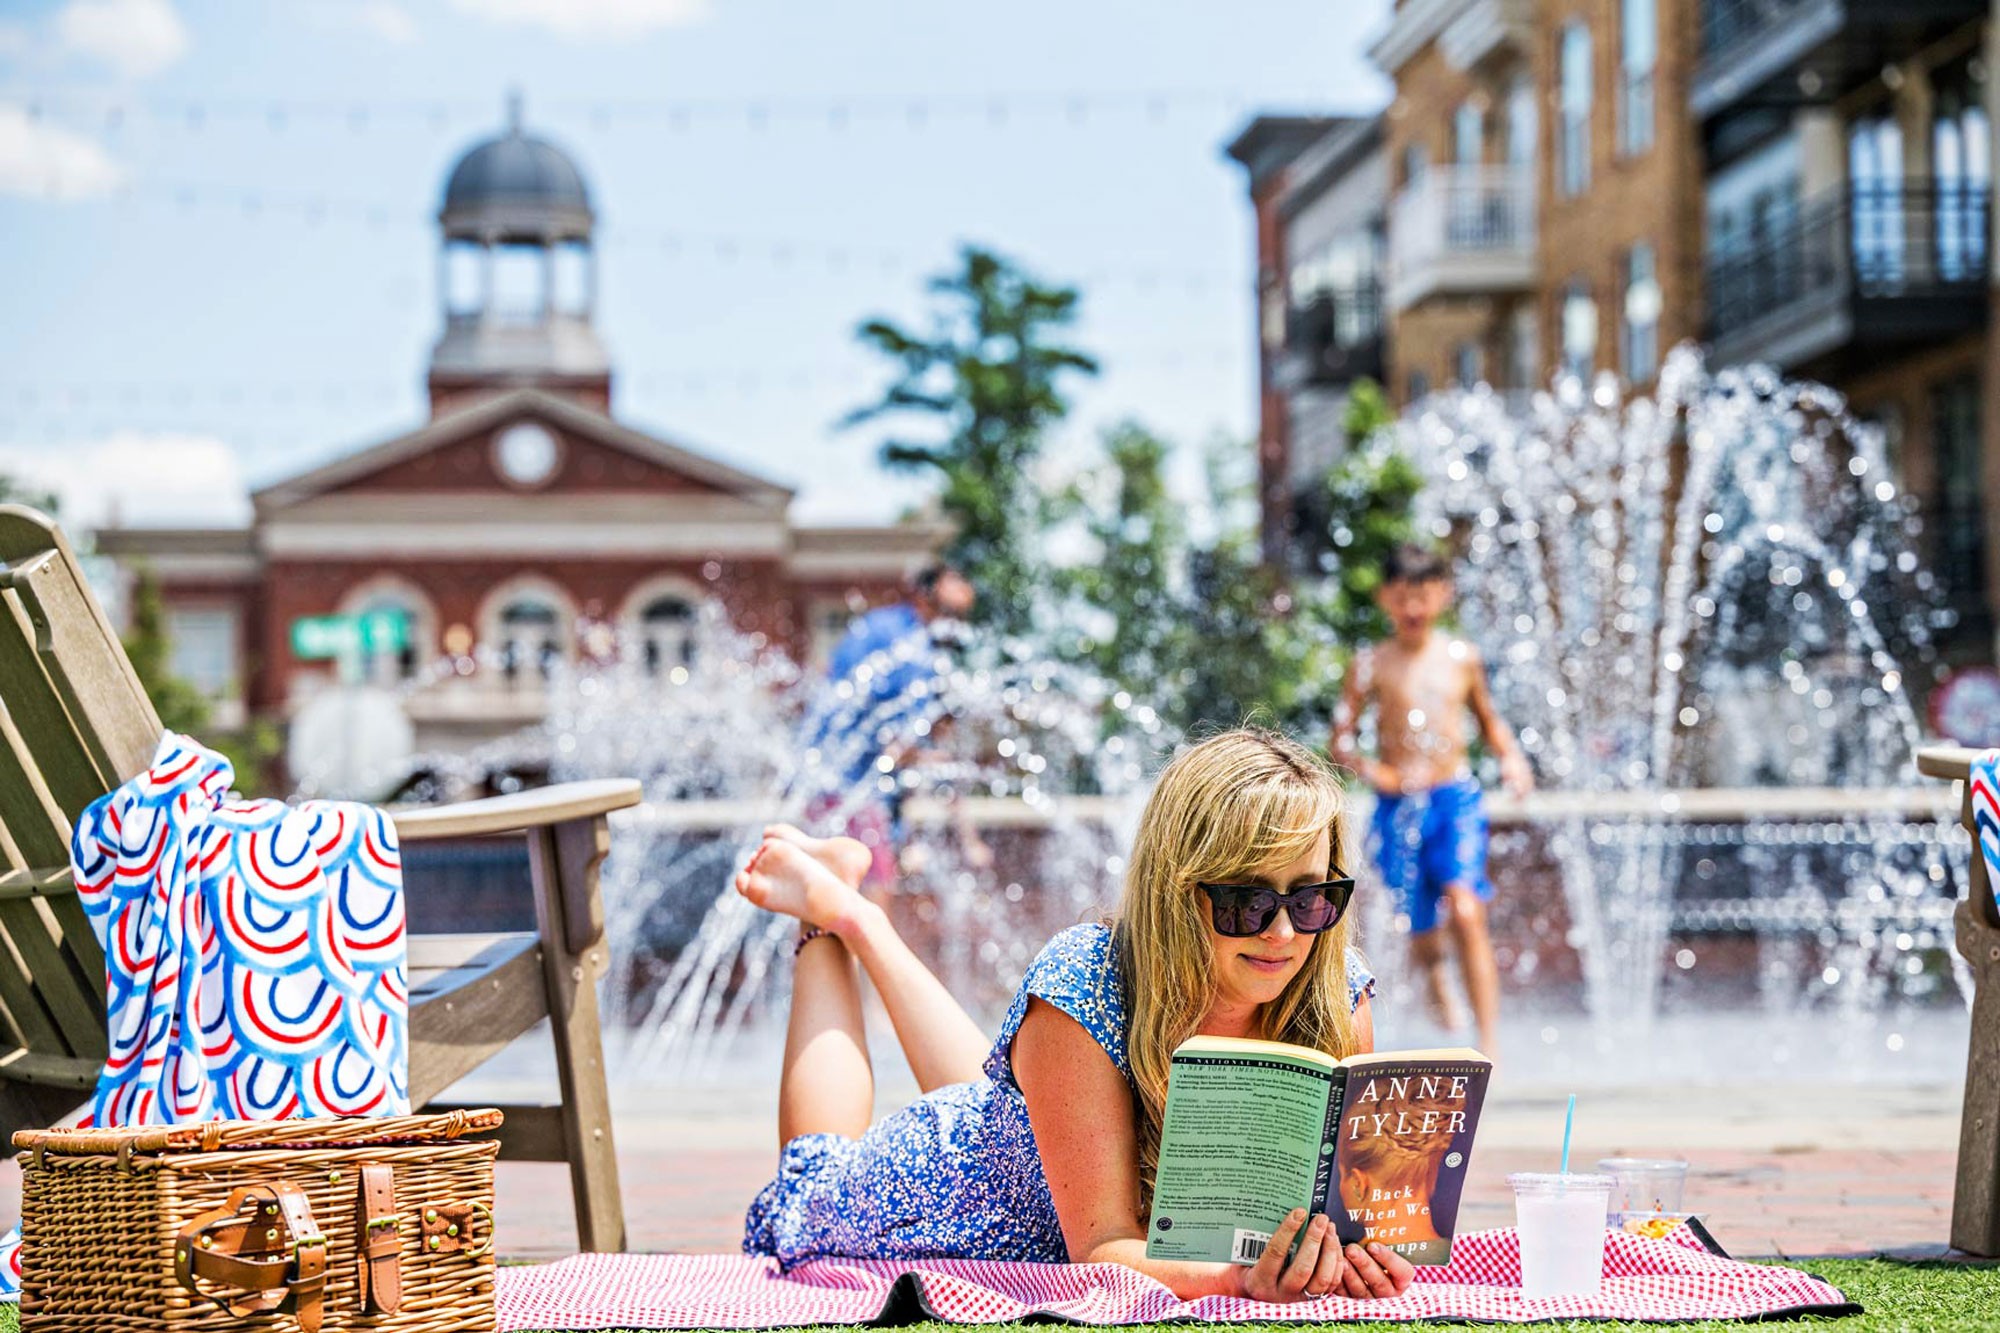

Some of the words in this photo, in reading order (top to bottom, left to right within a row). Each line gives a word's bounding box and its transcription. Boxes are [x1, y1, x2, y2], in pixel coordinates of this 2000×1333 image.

[1197, 1058, 1250, 1066] NATIONAL
[1258, 1061, 1325, 1079] BESTSELLER
[1257, 1068, 1296, 1079] NOTABLE
[1300, 1075, 1322, 1085] BOOK
[1358, 1075, 1469, 1104] ANNE
[1348, 1110, 1467, 1140] TYLER
[1313, 1159, 1330, 1203] ANNE
[1371, 1185, 1414, 1202] Back
[1346, 1208, 1397, 1222] When
[1405, 1202, 1430, 1217] We
[1364, 1225, 1407, 1240] Were
